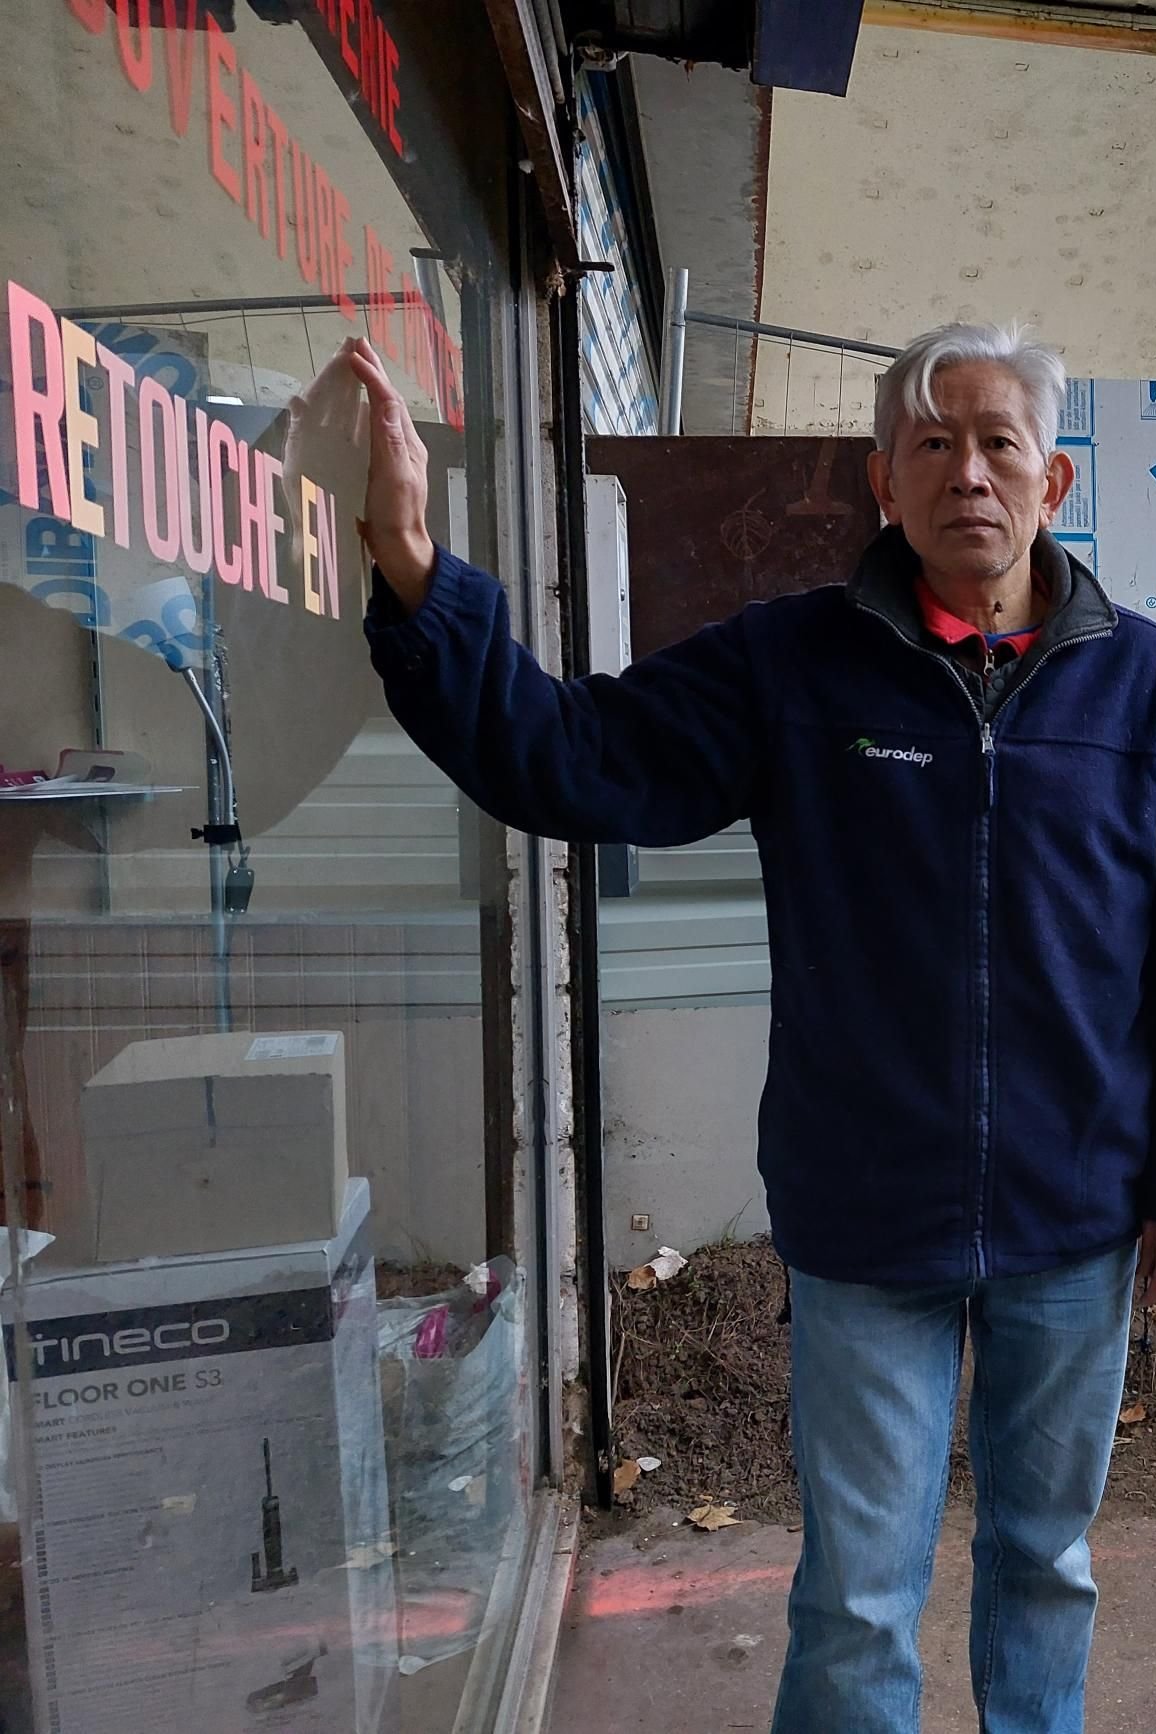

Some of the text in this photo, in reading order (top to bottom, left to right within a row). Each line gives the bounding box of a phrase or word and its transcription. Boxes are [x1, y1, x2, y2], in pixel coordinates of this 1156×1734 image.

[66, 0, 357, 322] UVERTURE
[8, 279, 340, 619] RETOUCHE EN
[865, 746, 933, 767] eurodep
[127, 1375, 187, 1397] ONE
[194, 1369, 224, 1389] S3
